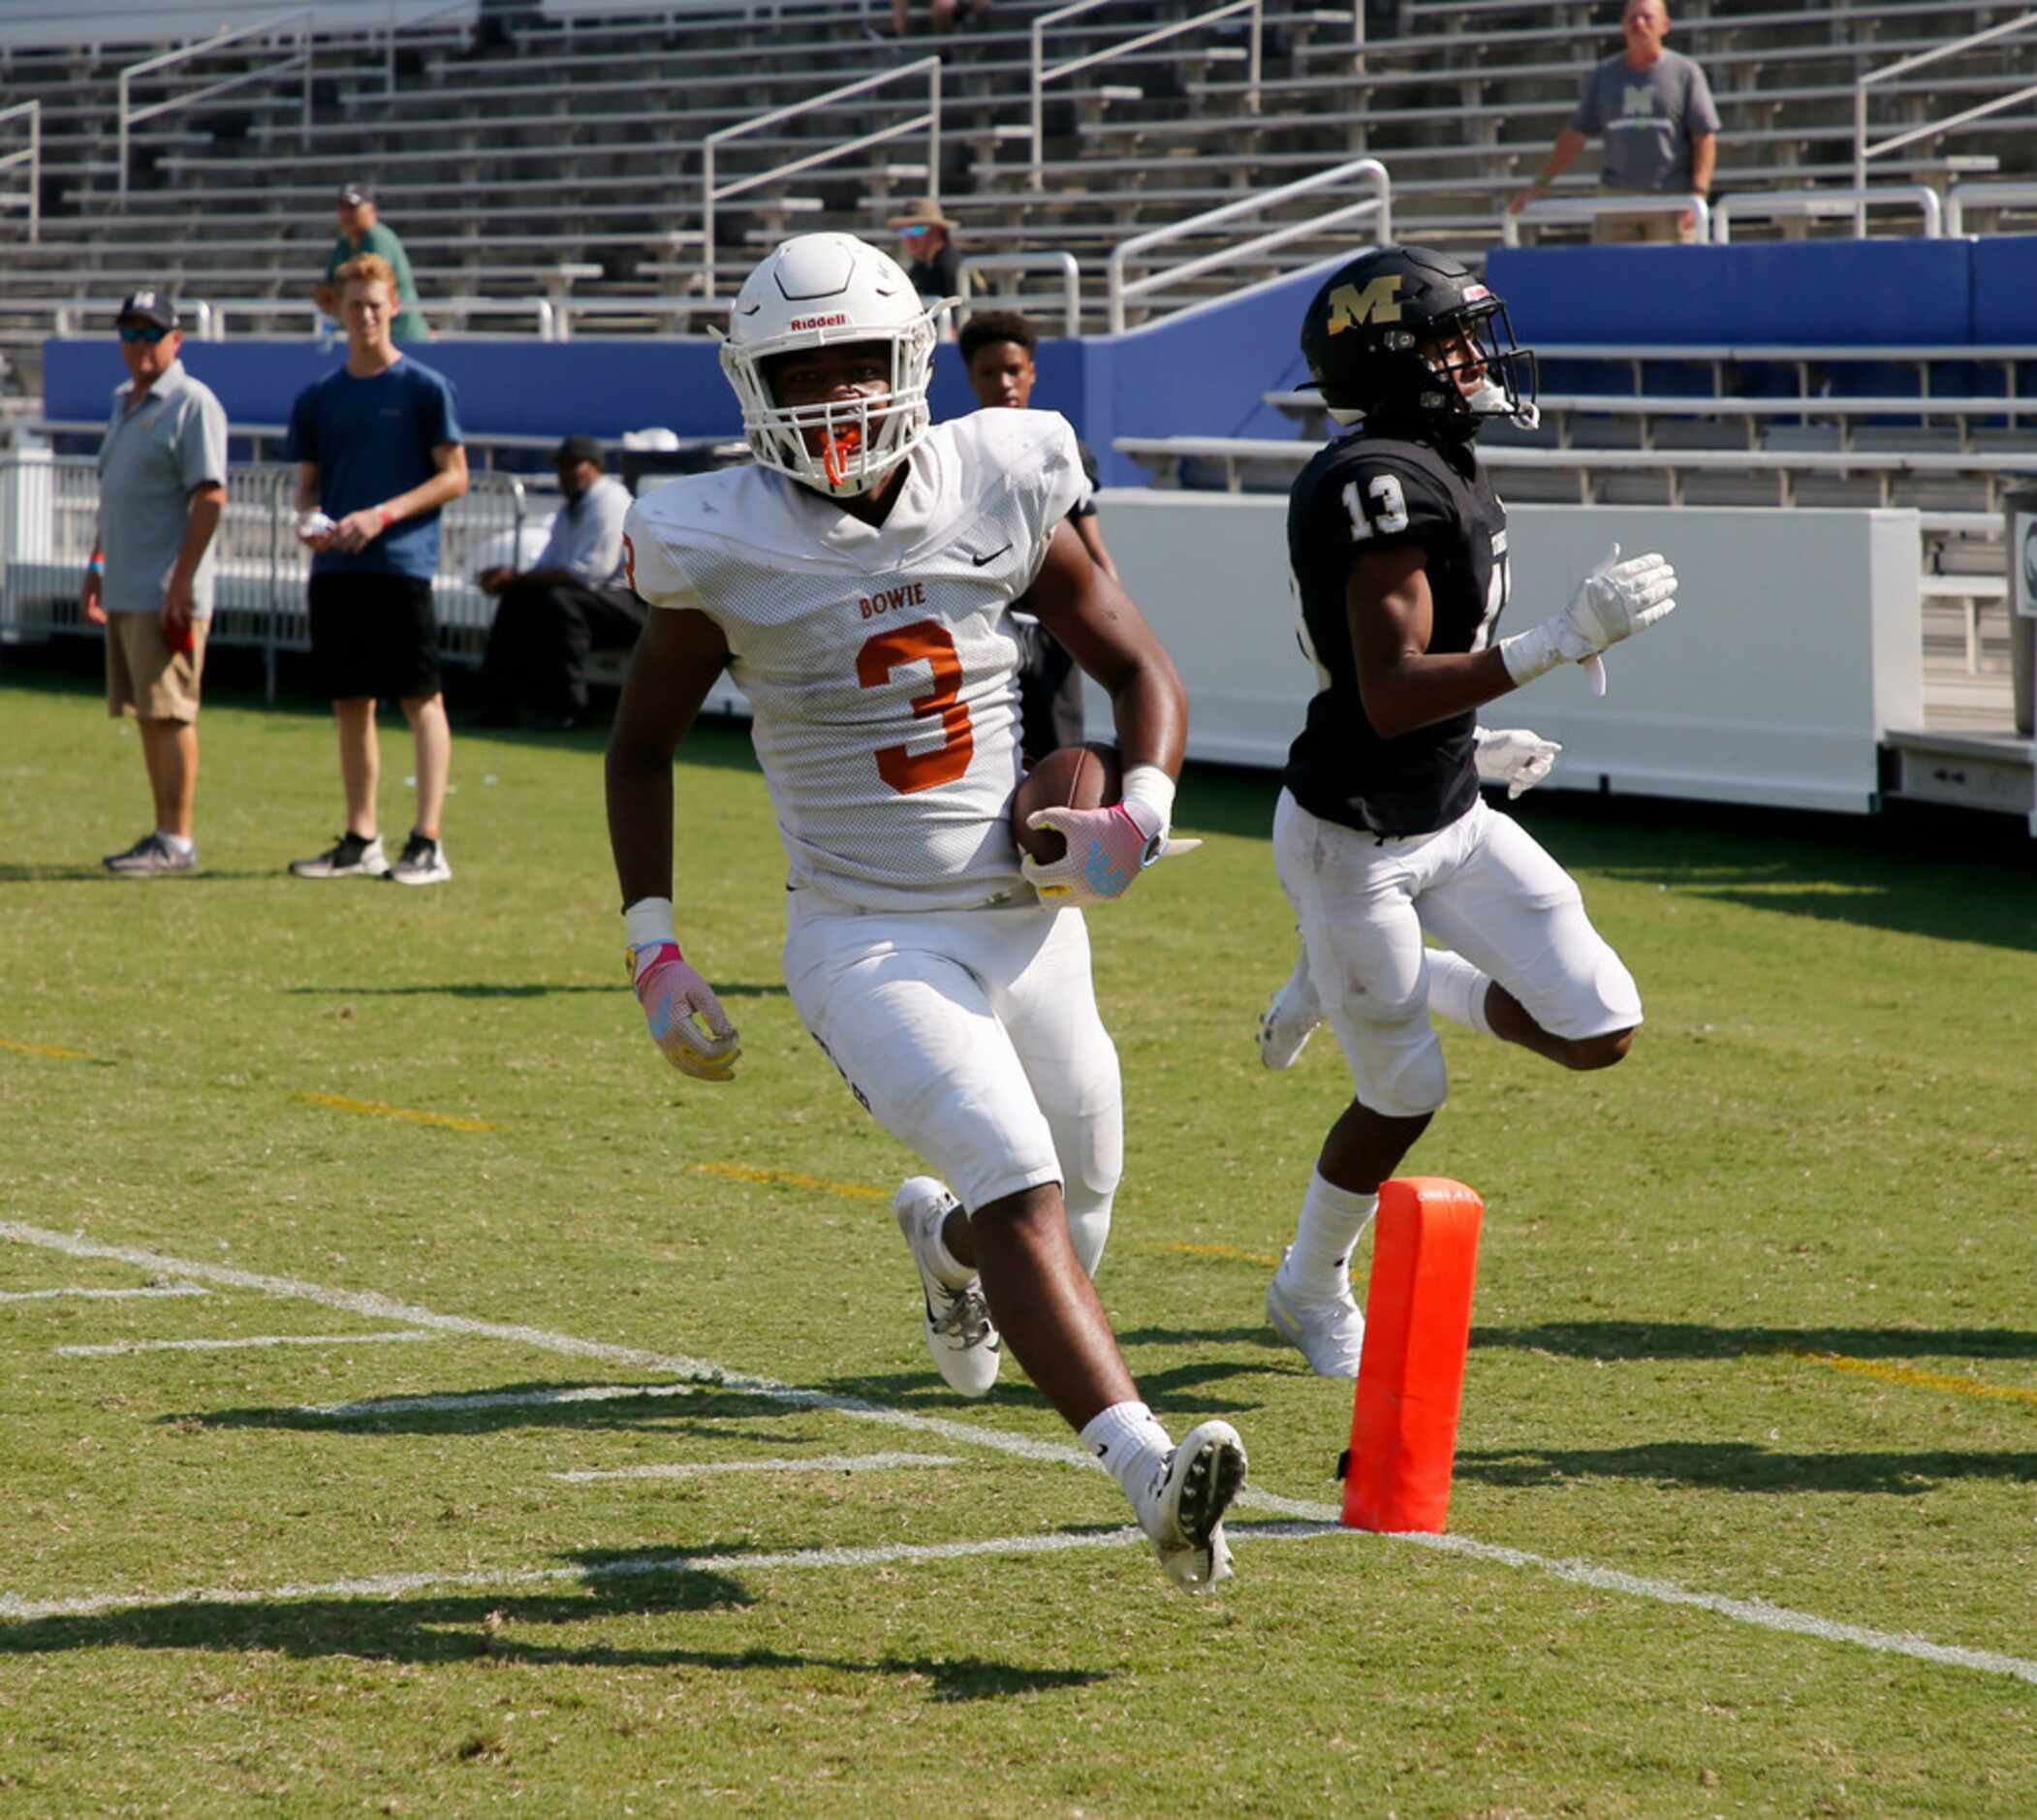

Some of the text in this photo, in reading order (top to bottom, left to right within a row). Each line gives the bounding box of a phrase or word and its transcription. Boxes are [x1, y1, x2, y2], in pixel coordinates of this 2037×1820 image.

[791, 313, 847, 330] Riddell
[1328, 275, 1401, 335] M
[1342, 474, 1408, 542] 13
[859, 582, 926, 619] BOWIE
[856, 618, 974, 795] 3
